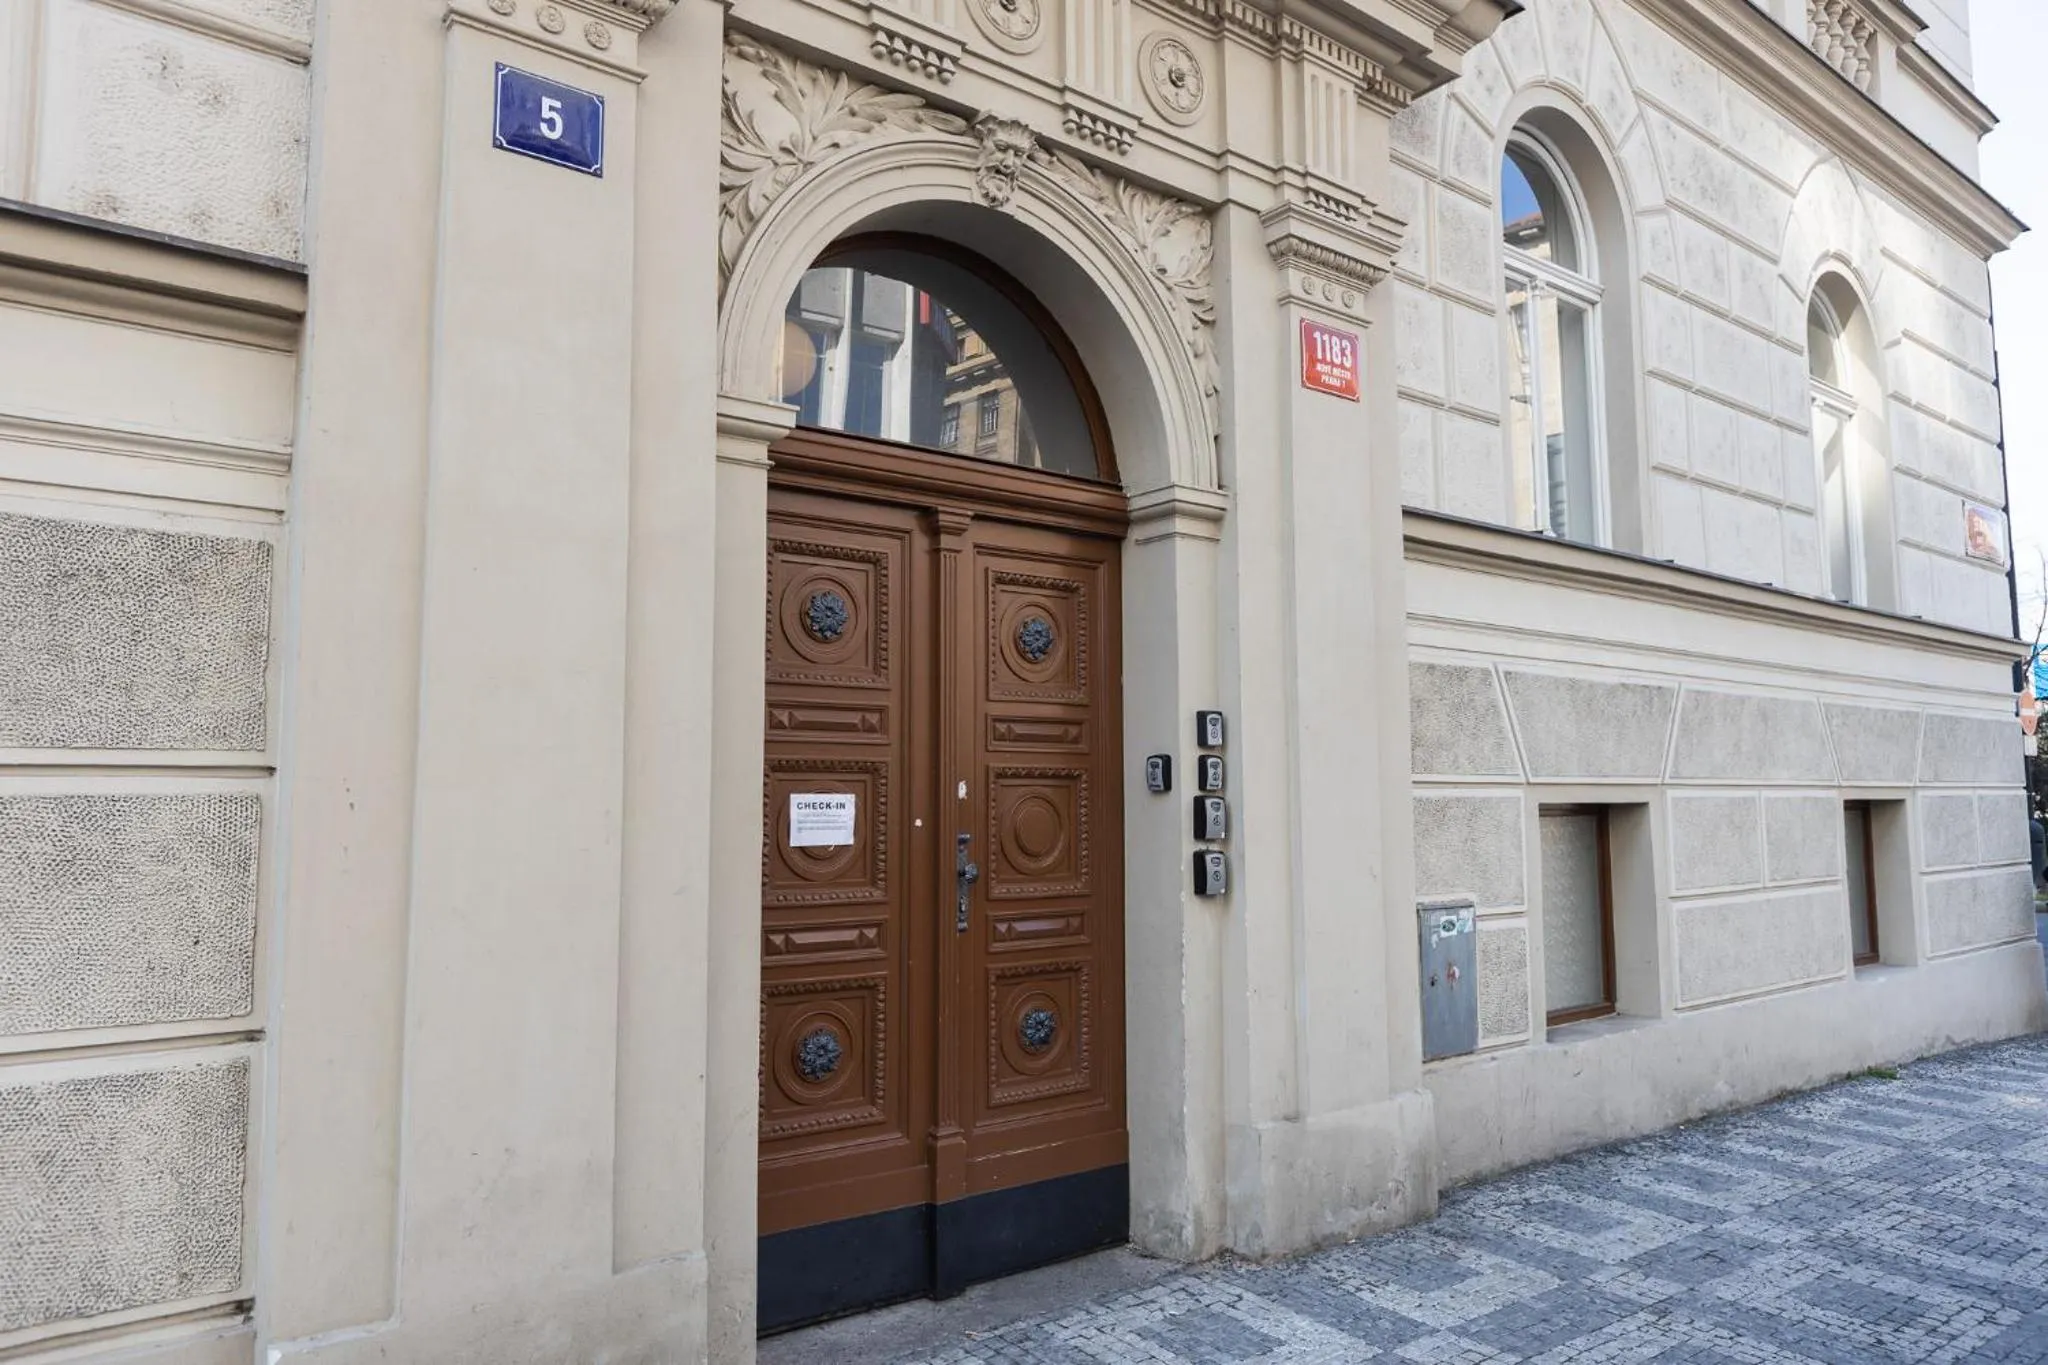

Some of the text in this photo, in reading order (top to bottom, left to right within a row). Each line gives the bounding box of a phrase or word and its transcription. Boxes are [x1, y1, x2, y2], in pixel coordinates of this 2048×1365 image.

[540, 96, 563, 140] 5
[1313, 330, 1352, 368] 1183
[797, 802, 846, 810] CHECK-IN
